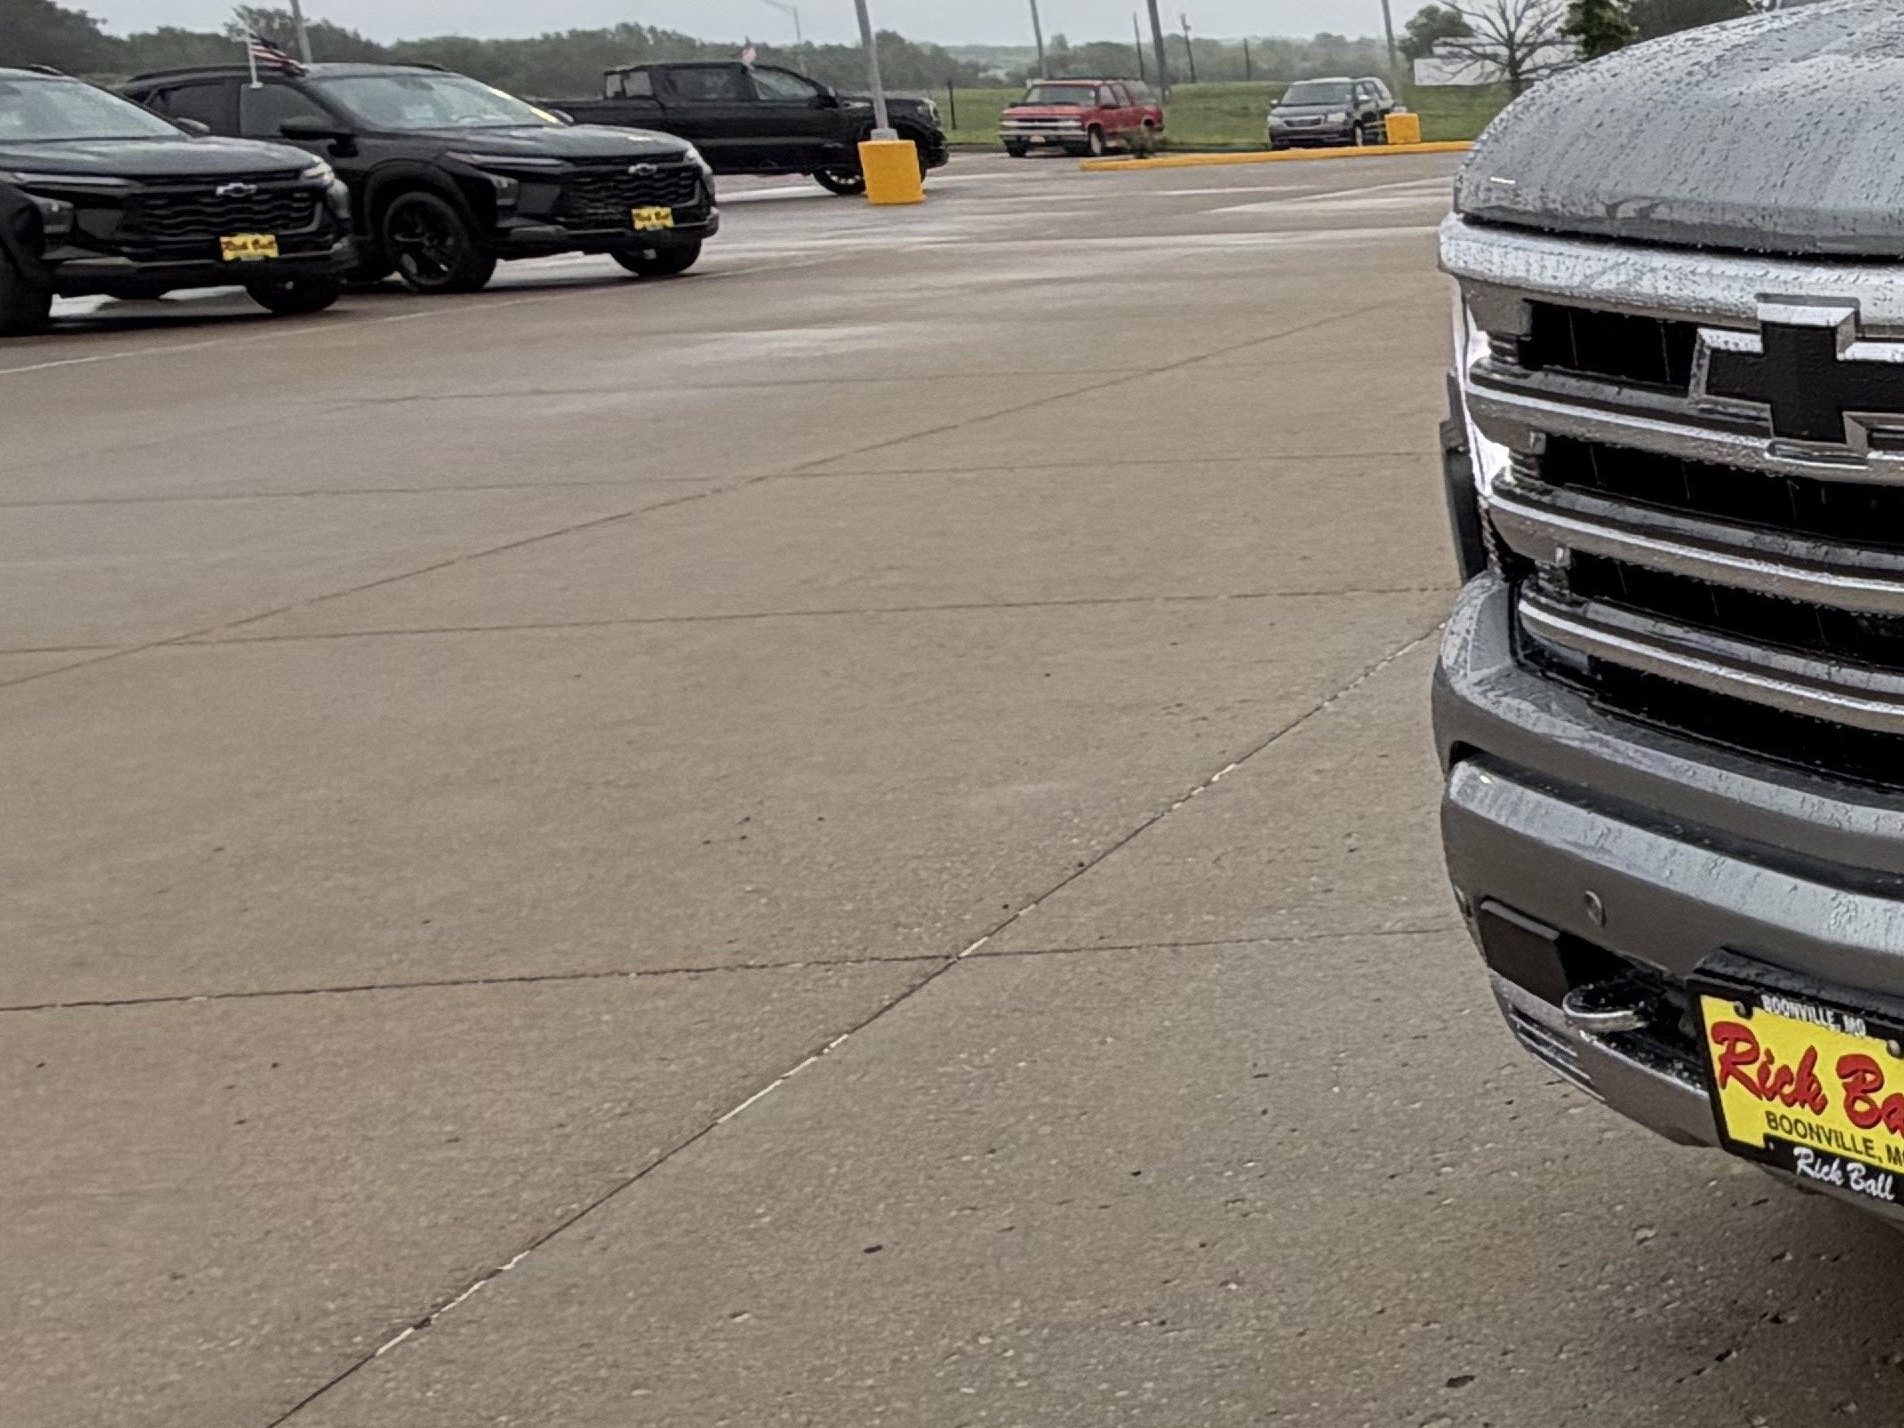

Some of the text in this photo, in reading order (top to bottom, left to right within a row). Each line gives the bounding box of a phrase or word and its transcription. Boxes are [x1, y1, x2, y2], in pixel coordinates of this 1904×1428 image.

[1711, 1020, 1829, 1116] Rick
[1765, 1110, 1883, 1164] BOONVILLE,
[1792, 1146, 1895, 1201] Rick Ball
